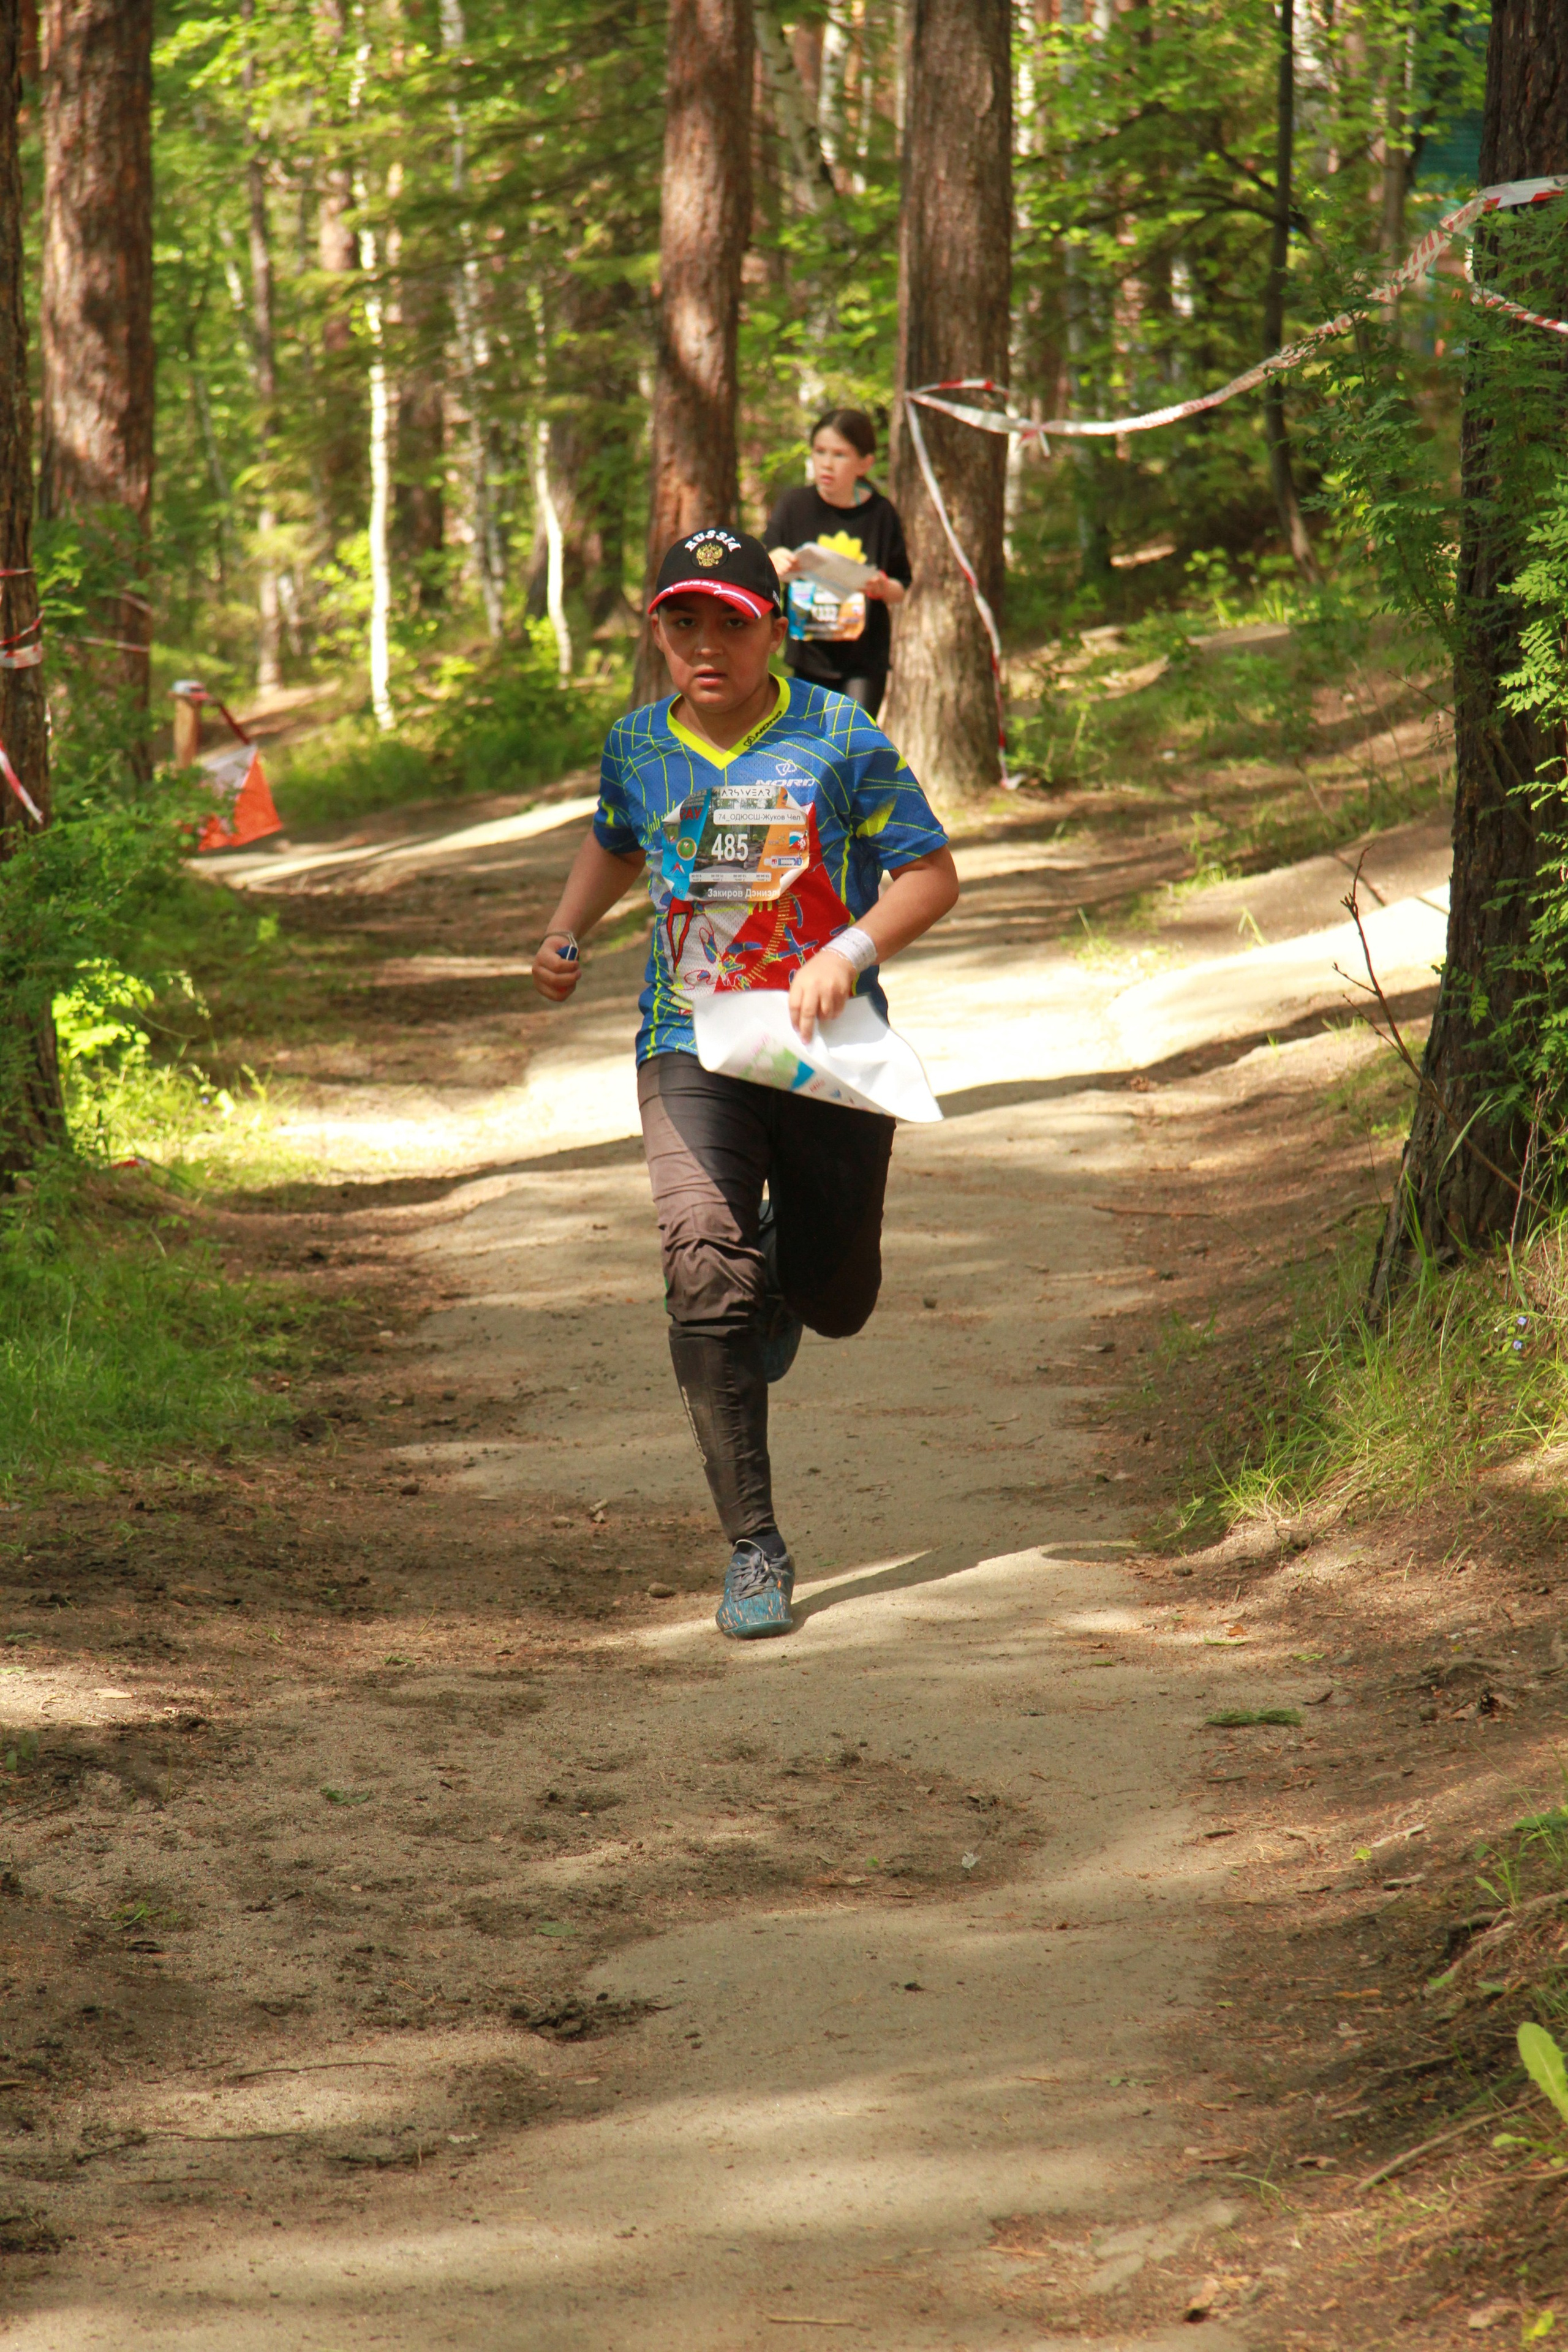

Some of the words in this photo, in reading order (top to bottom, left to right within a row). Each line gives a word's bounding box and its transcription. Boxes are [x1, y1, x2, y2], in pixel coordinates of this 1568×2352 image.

[684, 529, 742, 552] RUSSIA
[755, 710, 782, 738] NORD
[755, 778, 815, 786] NORD
[718, 813, 785, 822] 74_ОДЮСШ-Жуков
[787, 813, 801, 821] Чел
[711, 833, 749, 861] 485
[707, 888, 743, 899] Закиров
